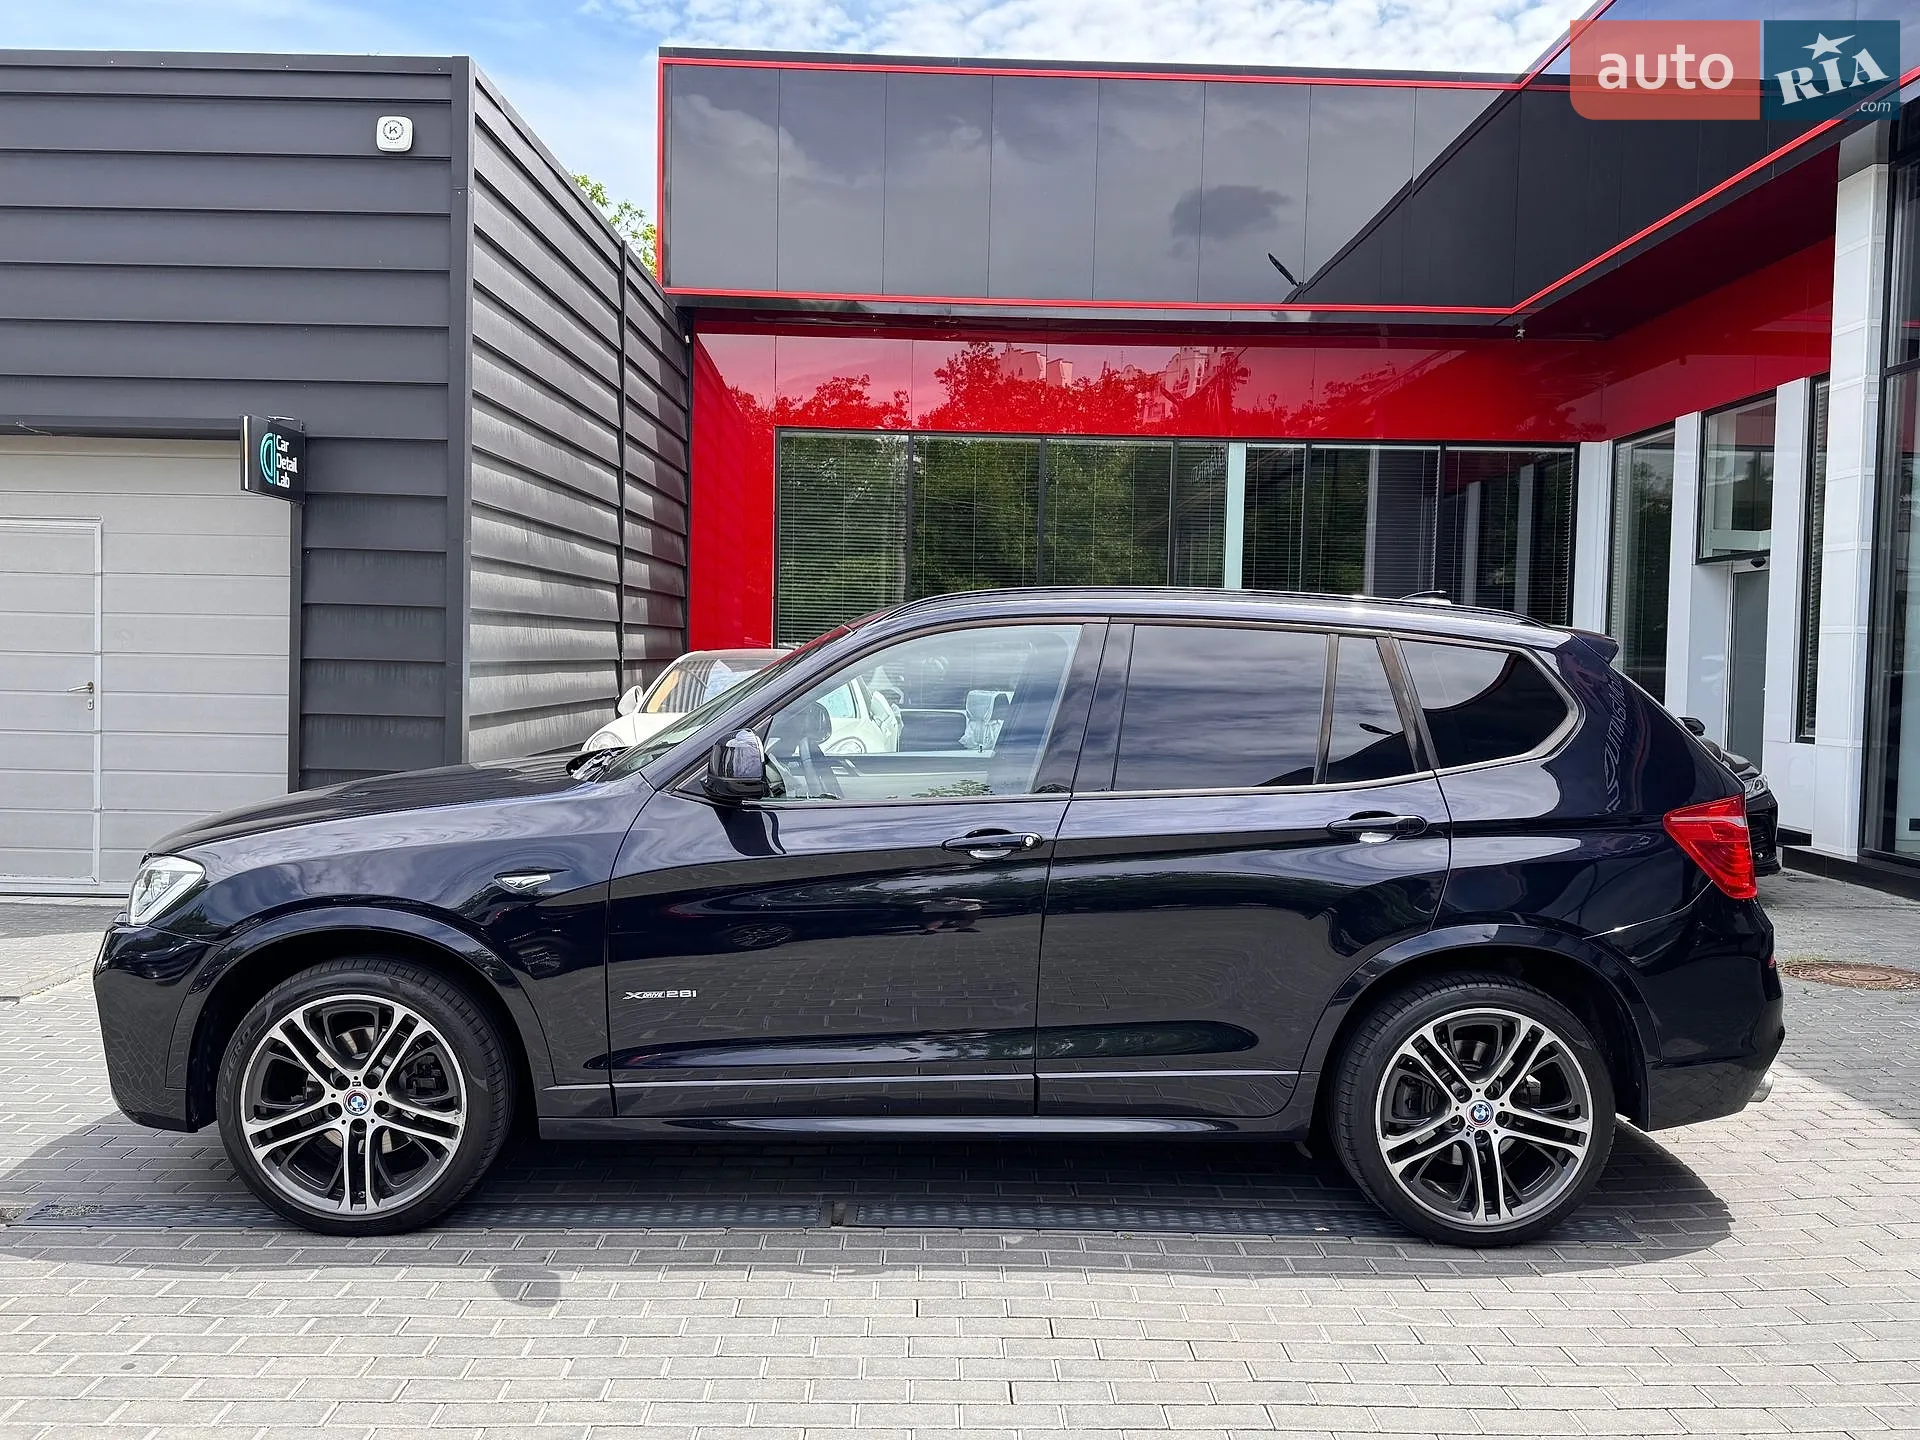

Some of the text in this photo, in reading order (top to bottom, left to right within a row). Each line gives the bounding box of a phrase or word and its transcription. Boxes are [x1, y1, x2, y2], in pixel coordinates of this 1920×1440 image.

[276, 435, 290, 453] Car
[276, 453, 298, 474] Detail
[276, 470, 291, 489] Lab
